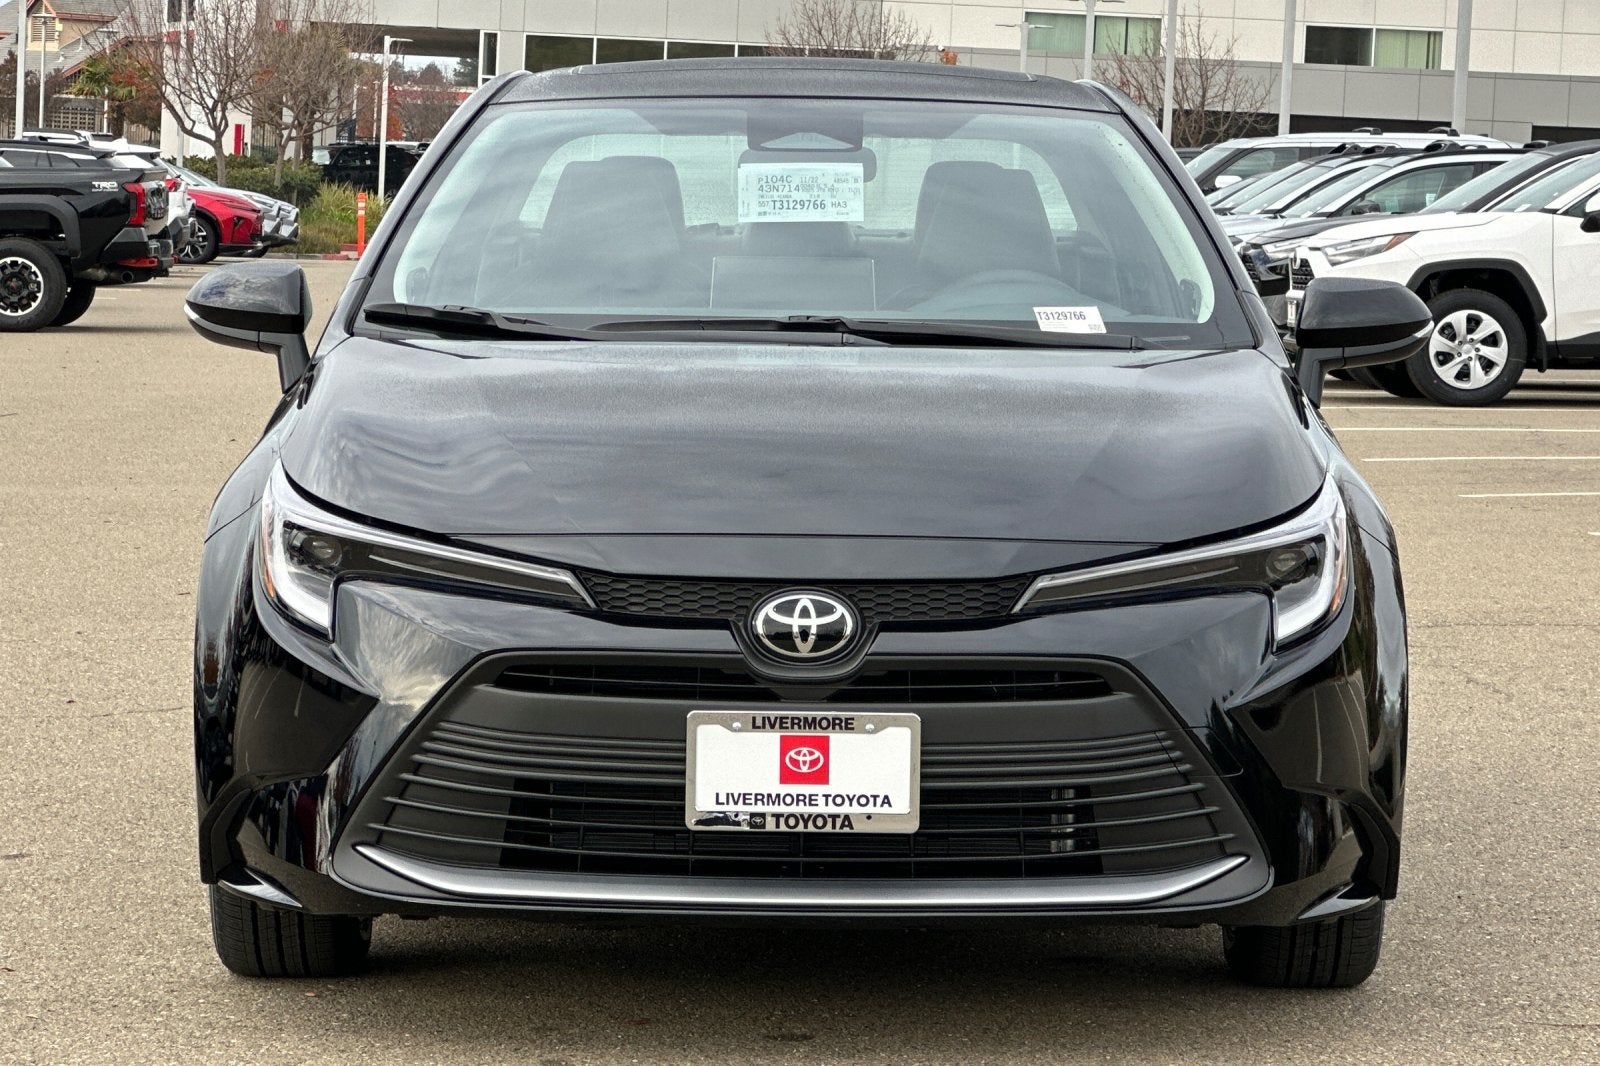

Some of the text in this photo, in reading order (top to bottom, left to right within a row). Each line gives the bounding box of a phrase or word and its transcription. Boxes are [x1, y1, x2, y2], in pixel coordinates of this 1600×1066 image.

[91, 181, 118, 190] TRD
[758, 184, 800, 193] 43N714
[771, 199, 826, 210] T3129766
[831, 200, 848, 209] HA3
[1036, 311, 1087, 321] T3129766
[751, 716, 855, 731] LIVERMORE
[715, 792, 892, 808] LIVERMORE TOYOTA
[771, 813, 854, 831] TOYOTA
